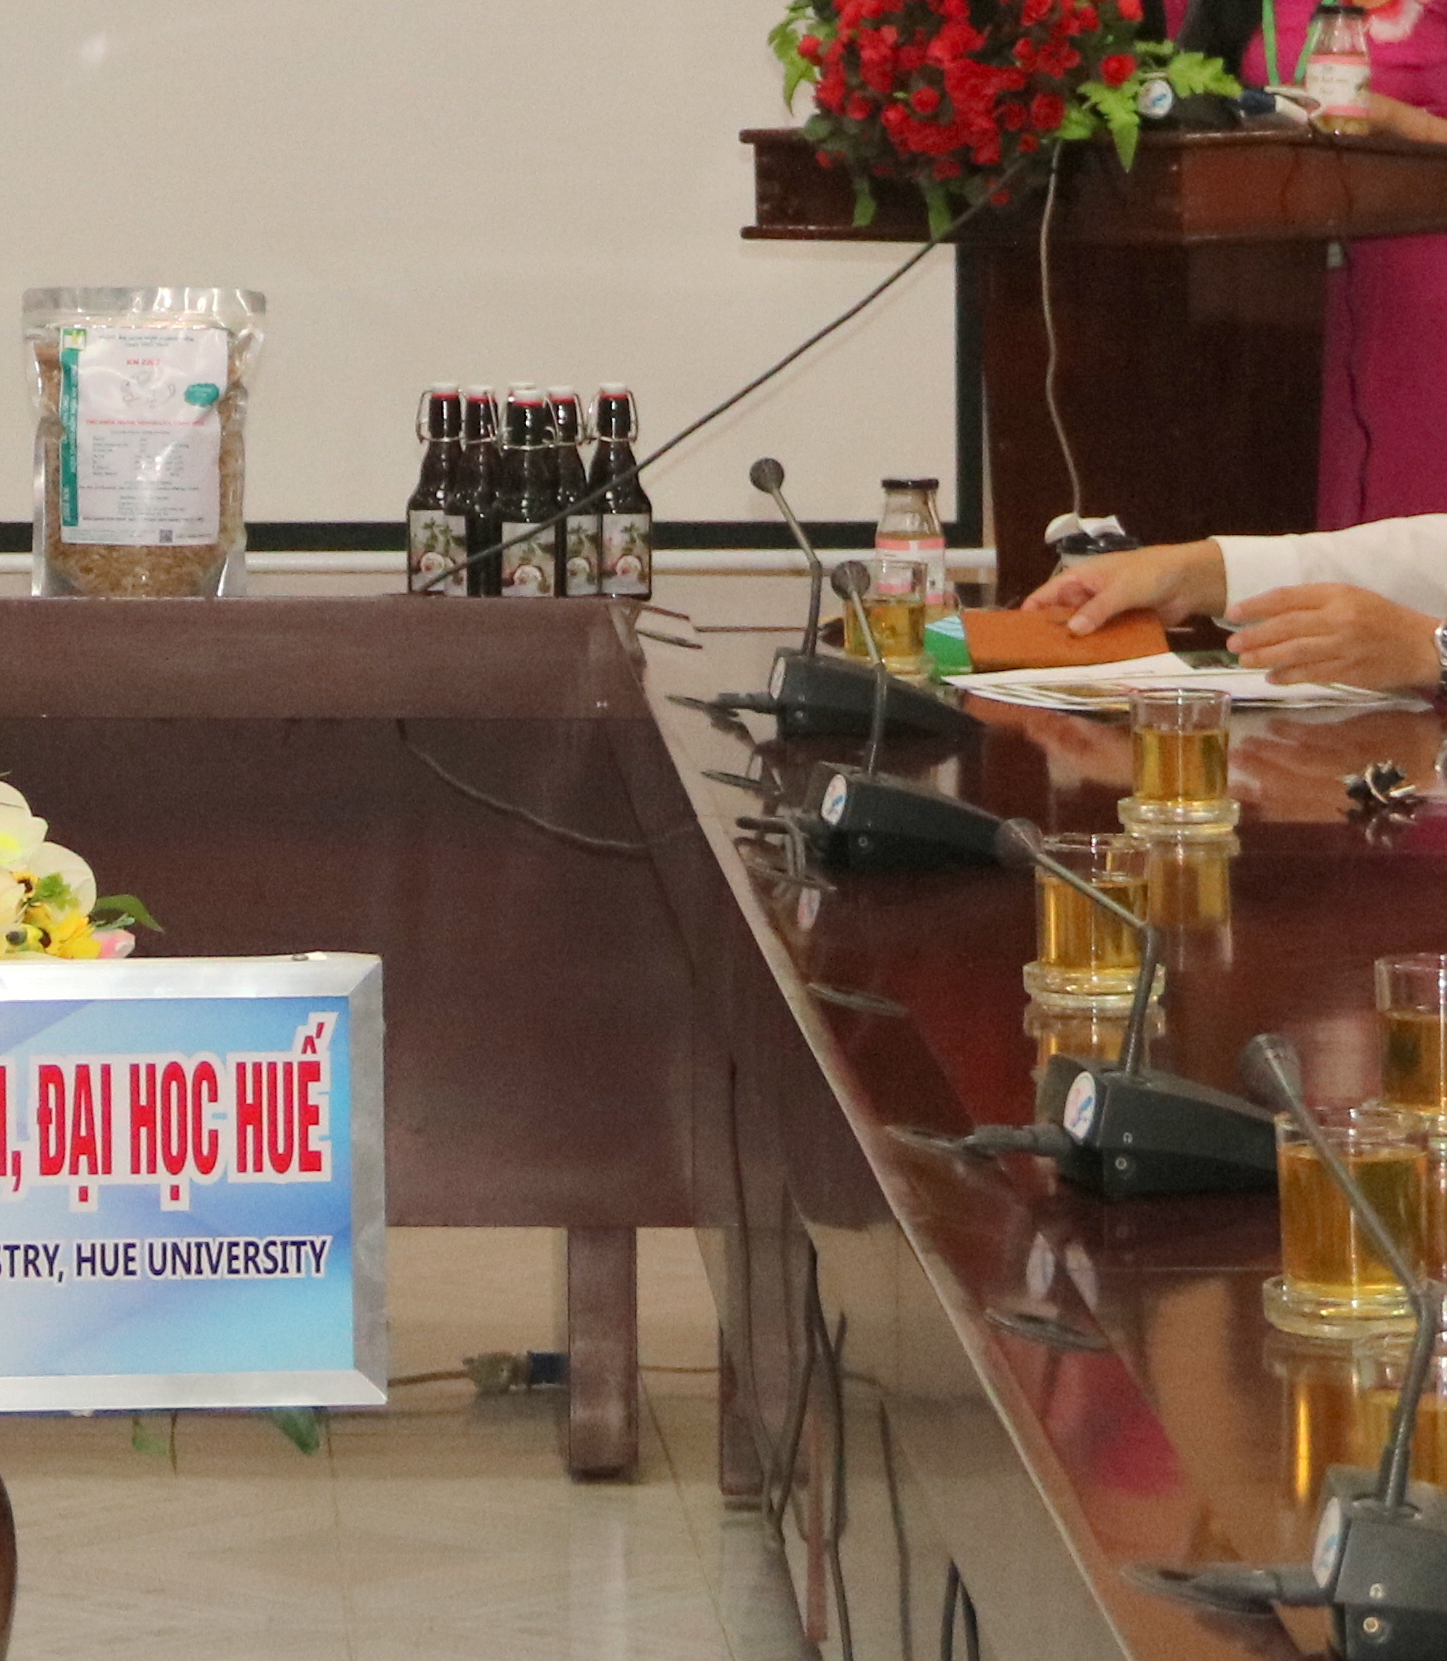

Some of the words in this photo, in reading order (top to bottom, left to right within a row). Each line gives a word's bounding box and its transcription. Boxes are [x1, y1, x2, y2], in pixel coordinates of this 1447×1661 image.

[36, 1063, 113, 1202] ĐẠI
[129, 1060, 219, 1202] HỌC
[236, 1021, 326, 1175] HUẾ
[76, 1242, 137, 1278] HUE
[148, 1239, 328, 1277] UNIVERSITY
